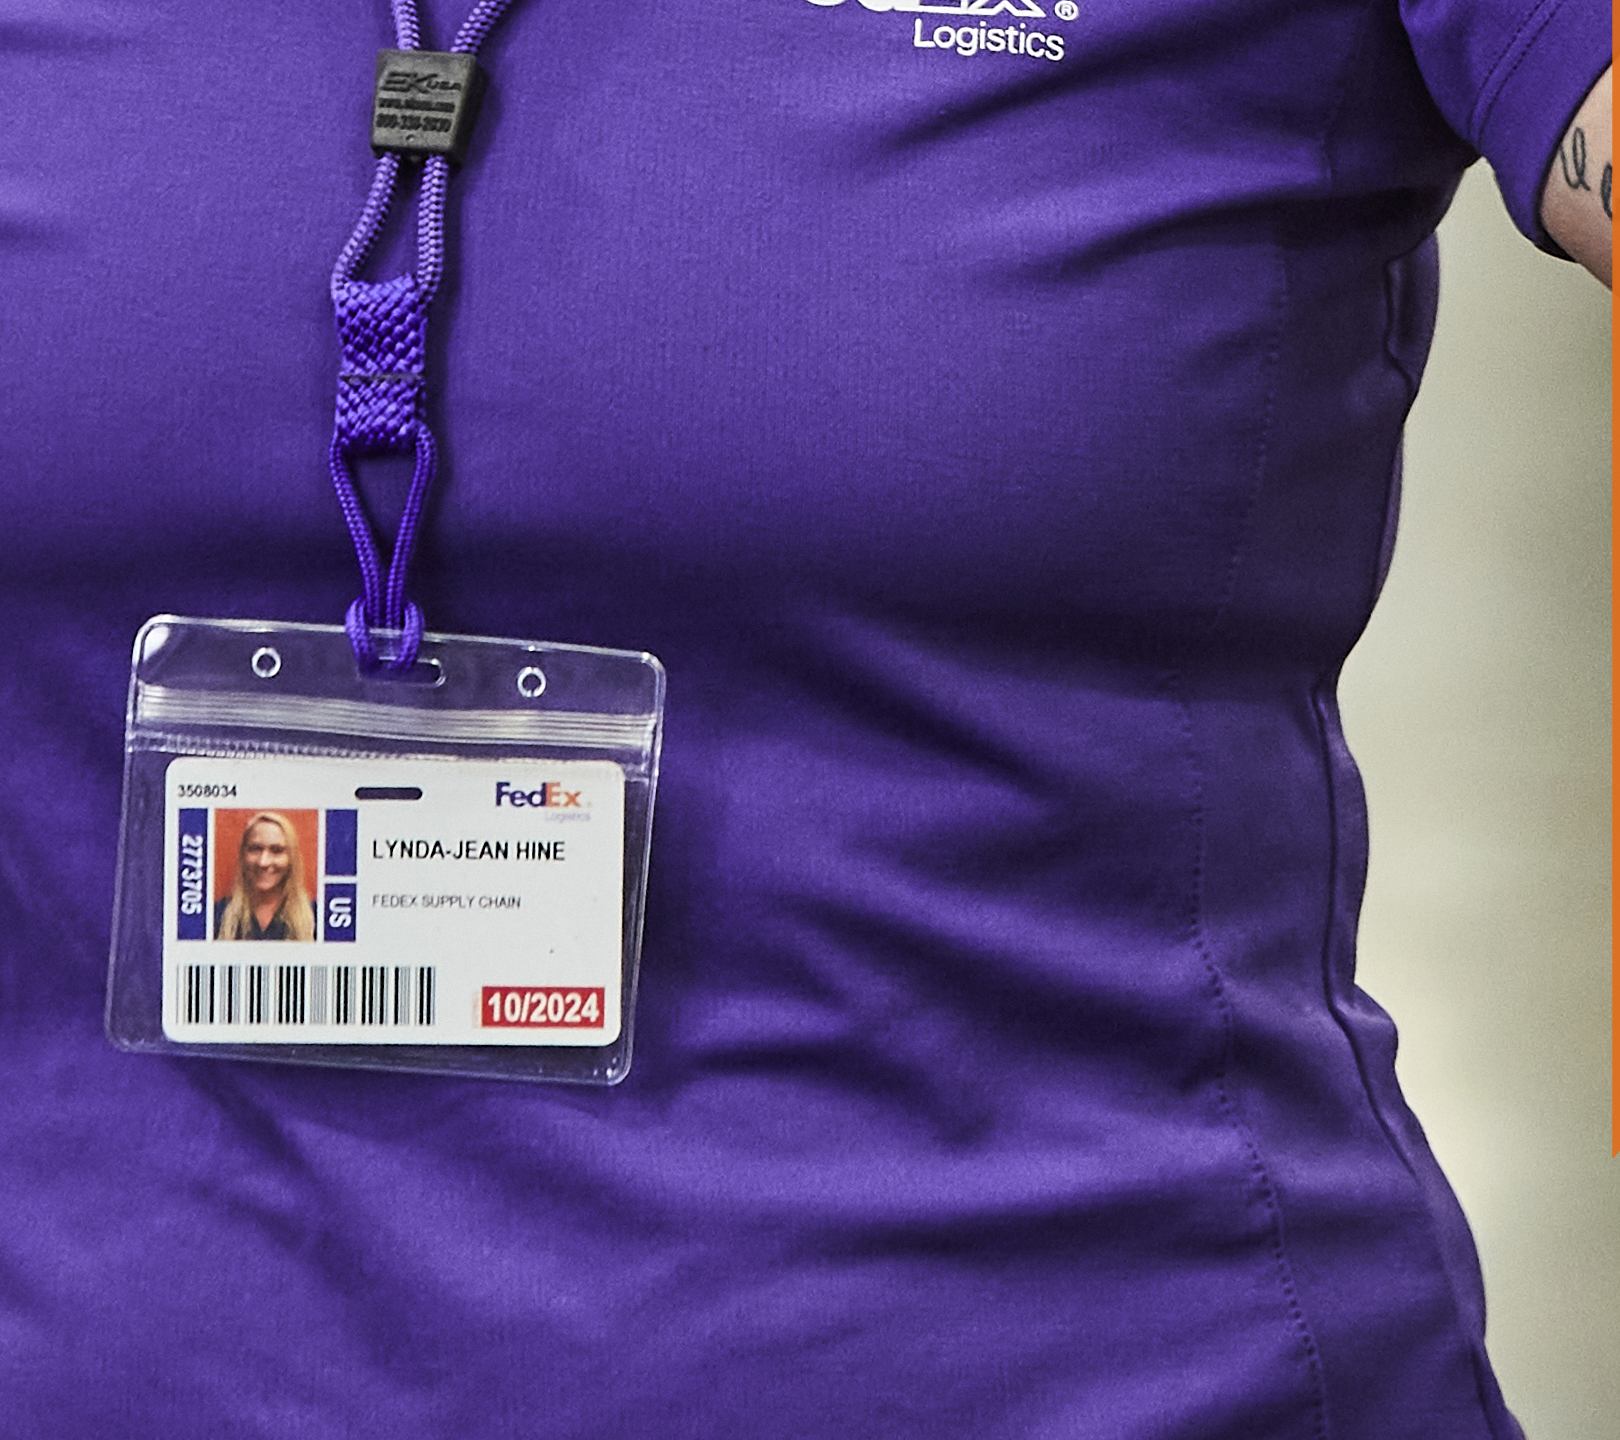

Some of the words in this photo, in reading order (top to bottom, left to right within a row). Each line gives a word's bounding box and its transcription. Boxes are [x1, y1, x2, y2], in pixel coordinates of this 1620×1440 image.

[913, 18, 1065, 62] Logistics
[177, 784, 238, 798] 3508034
[495, 781, 582, 808] FedEx
[372, 839, 508, 860] LYNDA-JEAN
[516, 841, 566, 861] HINE
[181, 833, 204, 916] 2773705
[328, 897, 352, 929] US
[372, 894, 417, 908] FEDEX
[422, 895, 476, 908] SUPPLY
[479, 895, 522, 909] CHAIN
[488, 991, 600, 1023] 10/2024
